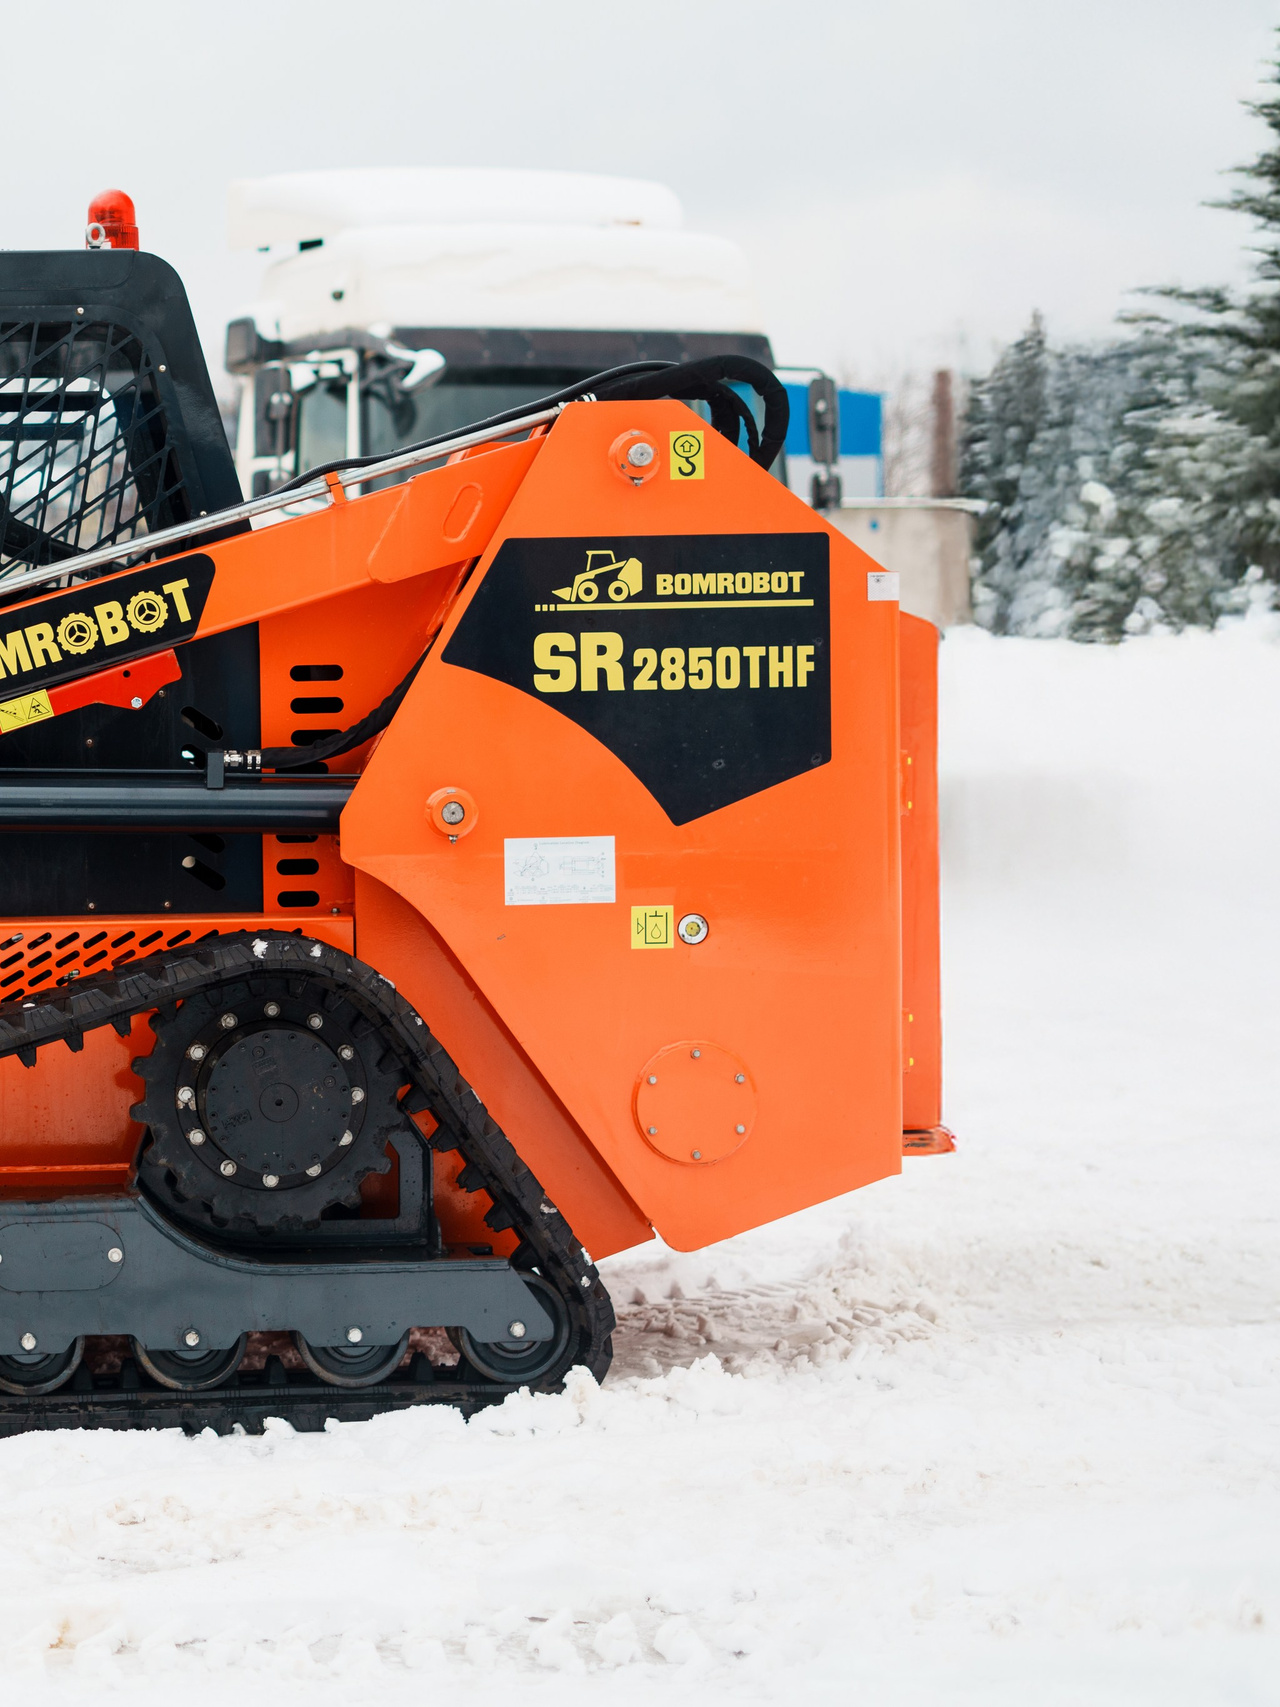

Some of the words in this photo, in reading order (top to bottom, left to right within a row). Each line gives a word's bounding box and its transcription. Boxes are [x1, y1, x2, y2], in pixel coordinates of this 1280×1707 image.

[656, 571, 805, 596] BOMROBOT
[533, 631, 626, 692] SR
[633, 645, 815, 691] 2850THF
